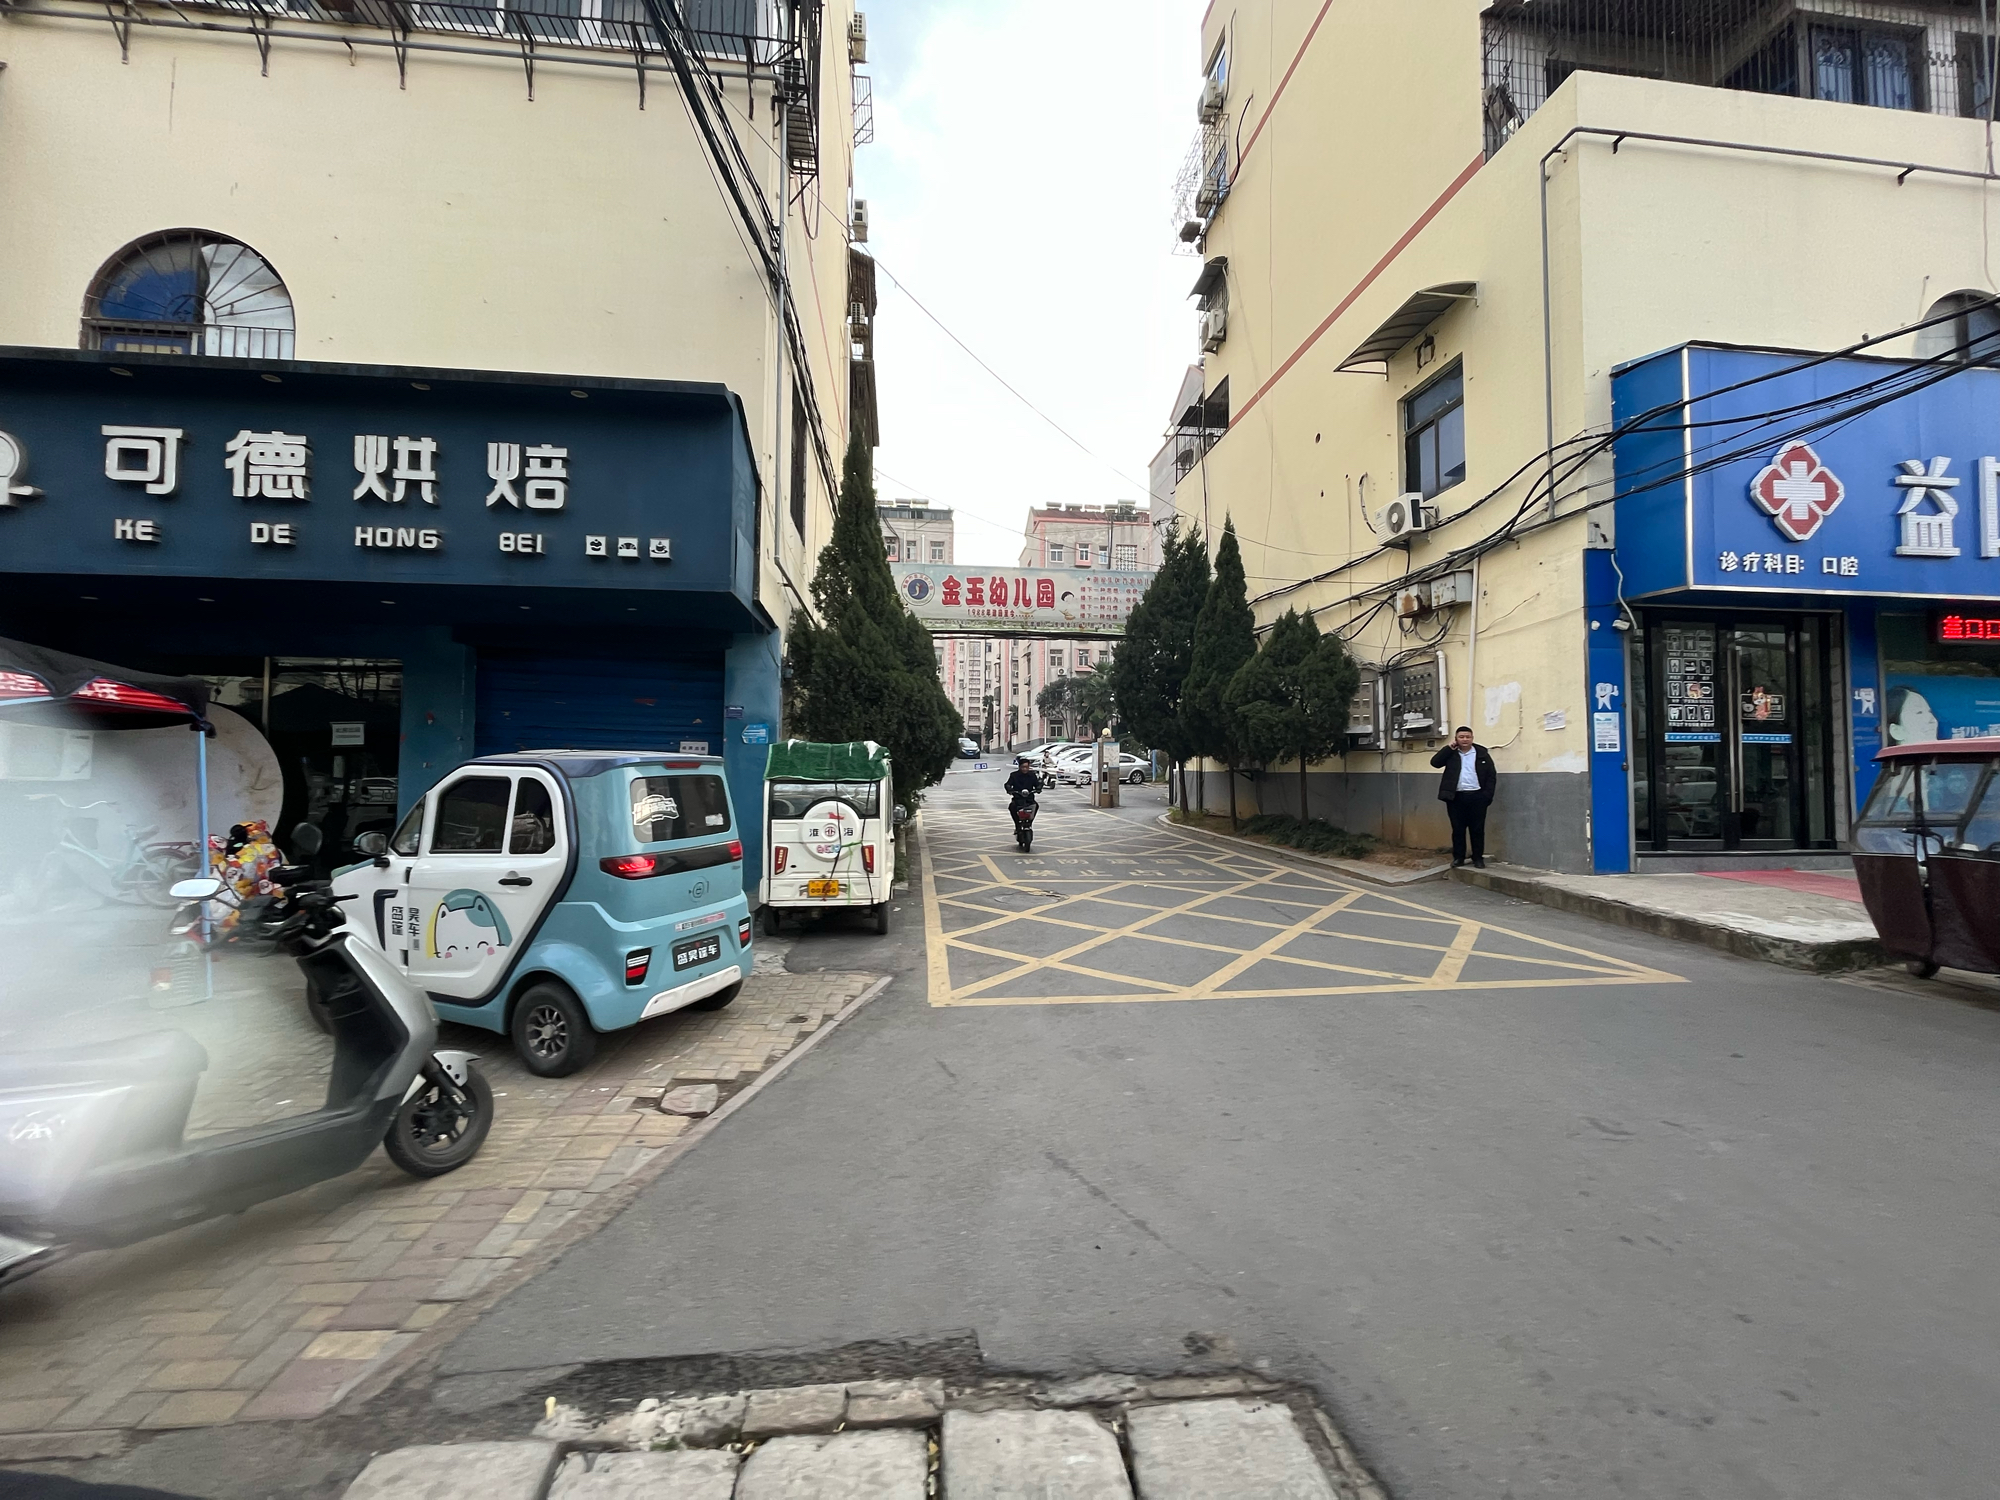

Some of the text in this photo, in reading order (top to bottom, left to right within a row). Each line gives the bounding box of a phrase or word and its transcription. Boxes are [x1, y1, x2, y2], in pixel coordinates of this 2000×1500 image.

[101, 424, 570, 510] 可德烘焙
[115, 518, 543, 553] KE DE HONG BEI
[1719, 550, 1859, 577] 诊疗科目： 口腔
[941, 575, 1055, 609] 金玉幼儿园
